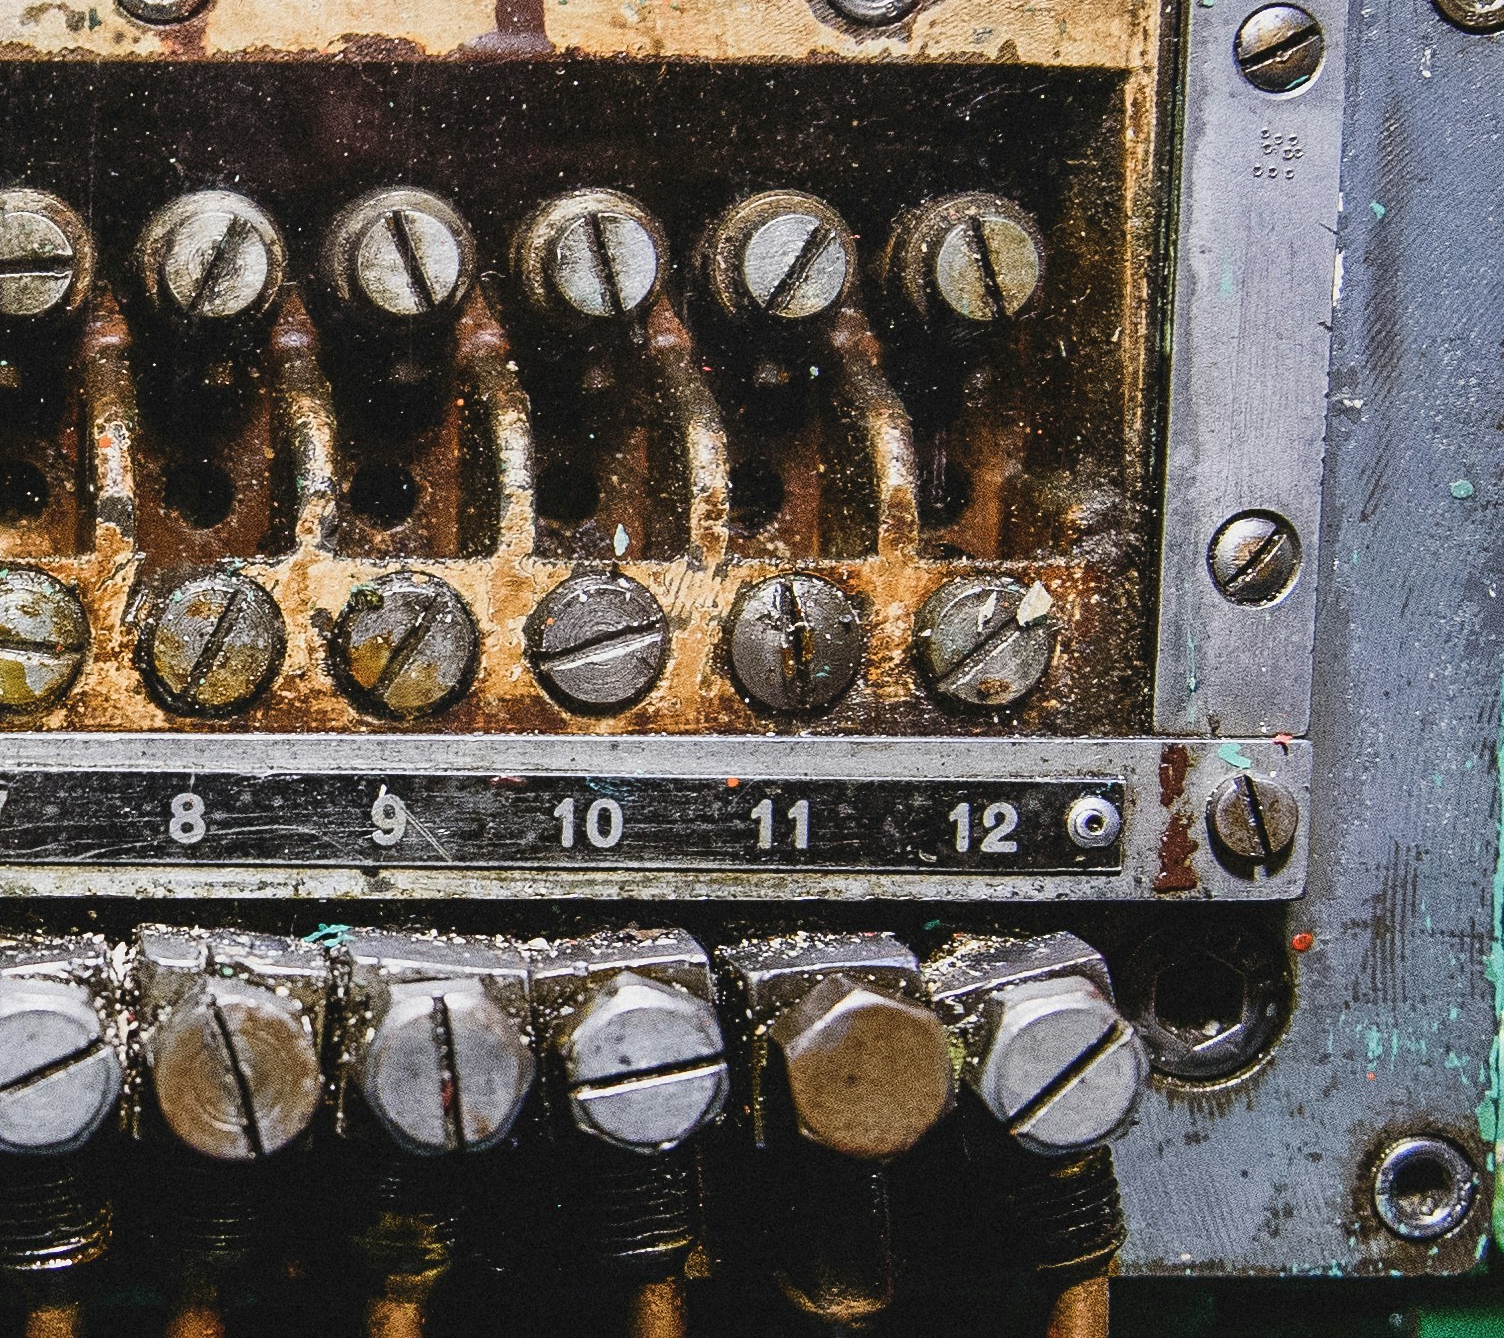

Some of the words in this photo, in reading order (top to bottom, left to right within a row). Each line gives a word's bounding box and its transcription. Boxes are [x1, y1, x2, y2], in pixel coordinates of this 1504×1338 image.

[167, 791, 207, 846] 8
[369, 792, 409, 847] 9
[552, 796, 625, 850] 10
[748, 797, 810, 850] 11
[947, 800, 1020, 854] 12
